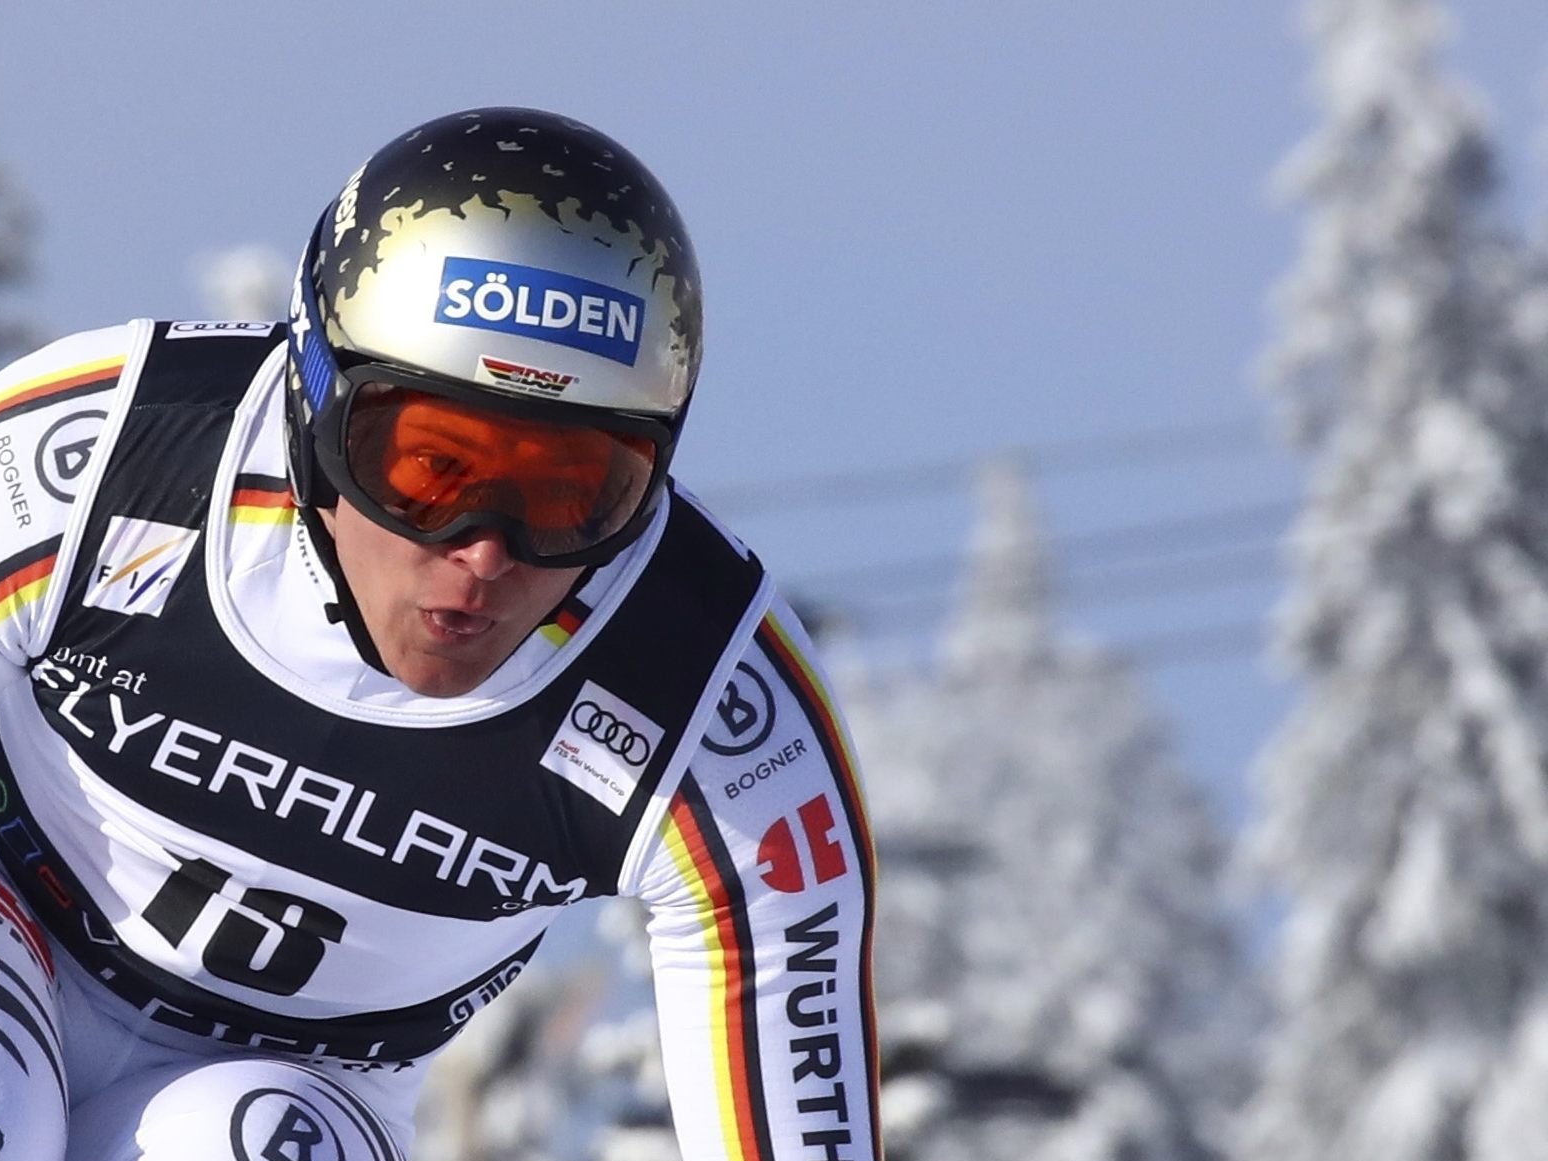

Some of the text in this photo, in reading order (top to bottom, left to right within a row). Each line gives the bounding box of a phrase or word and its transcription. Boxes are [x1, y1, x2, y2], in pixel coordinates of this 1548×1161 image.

[444, 271, 637, 343] SÖLDEN
[111, 669, 148, 696] at
[557, 739, 581, 755] Audi
[583, 762, 610, 785] World
[609, 780, 626, 797] Cup
[724, 738, 808, 799] BOGNER
